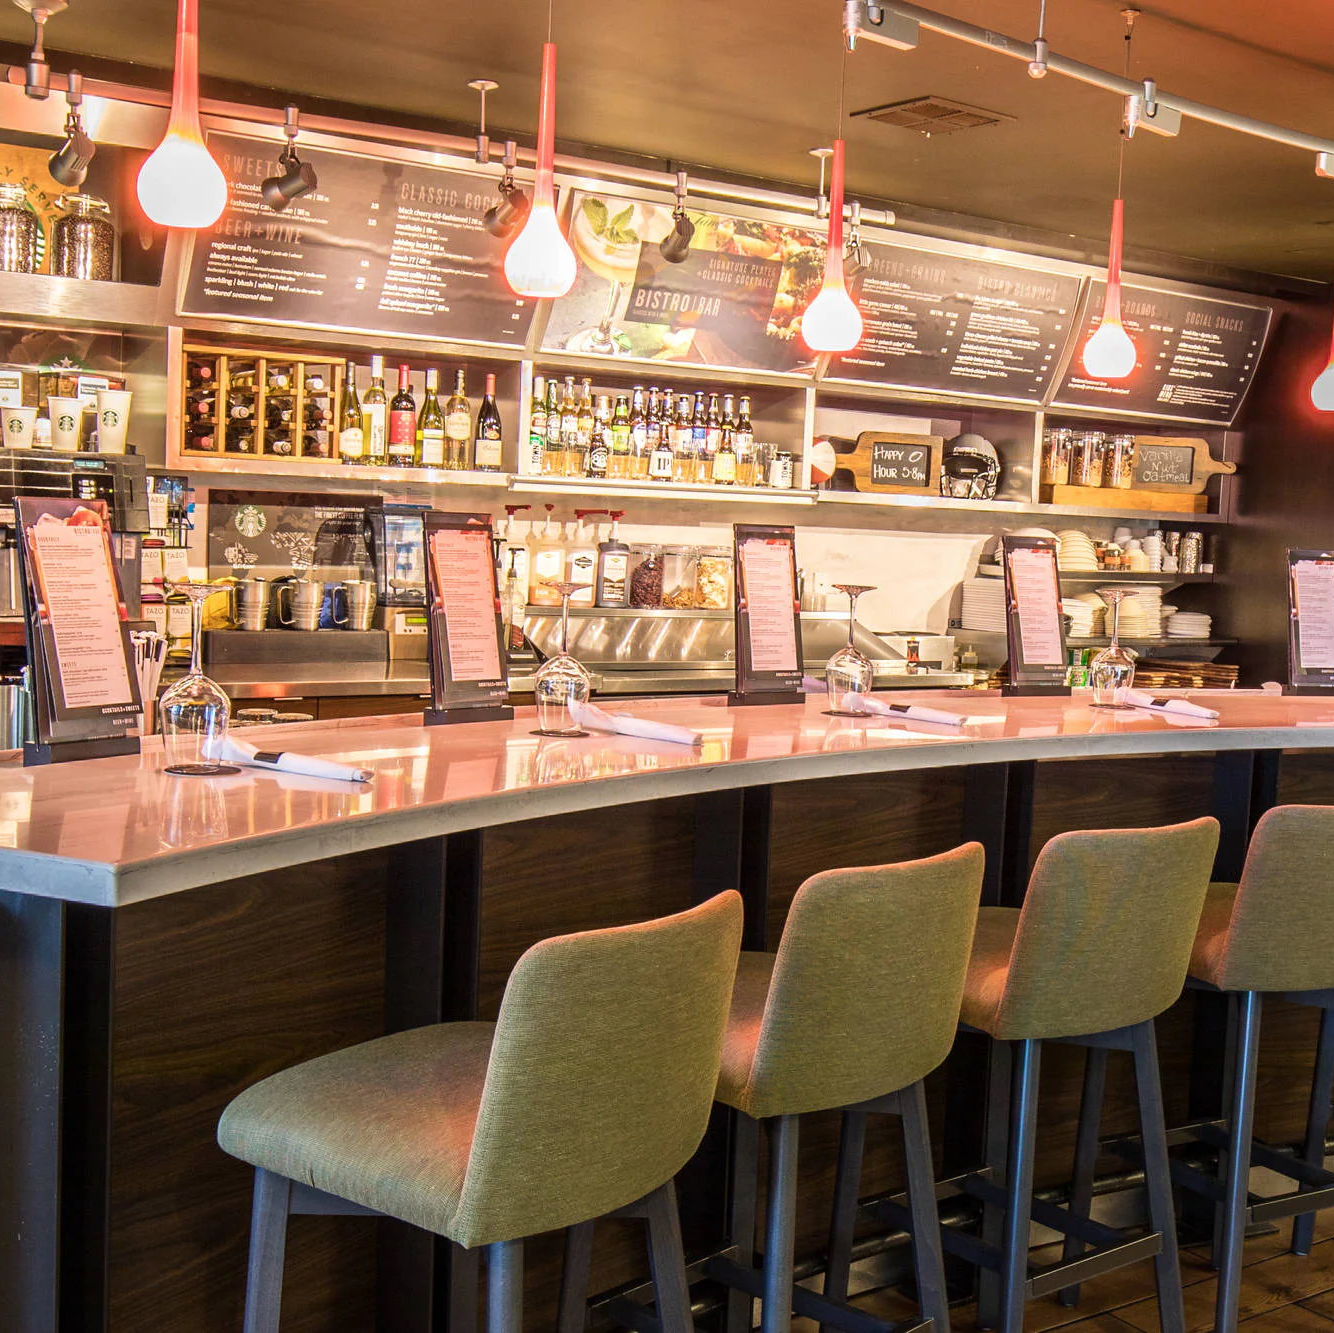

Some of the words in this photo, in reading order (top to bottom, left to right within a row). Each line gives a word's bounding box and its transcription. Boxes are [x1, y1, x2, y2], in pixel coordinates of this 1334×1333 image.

[223, 153, 285, 178] SWEETS
[235, 182, 263, 193] chocolat
[401, 182, 457, 208] CLASSIC
[211, 241, 236, 251] regional
[236, 244, 252, 253] craft
[708, 258, 748, 274] SIGNATURE
[750, 262, 777, 277] PLATES
[204, 275, 233, 287] sparkling
[735, 272, 775, 288] COCKTAILS
[635, 288, 690, 312] BISTRO
[697, 296, 721, 317] BAR
[1185, 310, 1212, 328] SOCIAL
[1215, 315, 1244, 332] SNACKS
[1138, 449, 1184, 463] Vanilla
[873, 463, 898, 479] HOUR
[166, 551, 185, 559] TAZO
[145, 607, 164, 615] TAZO
[171, 607, 191, 615] TAZO
